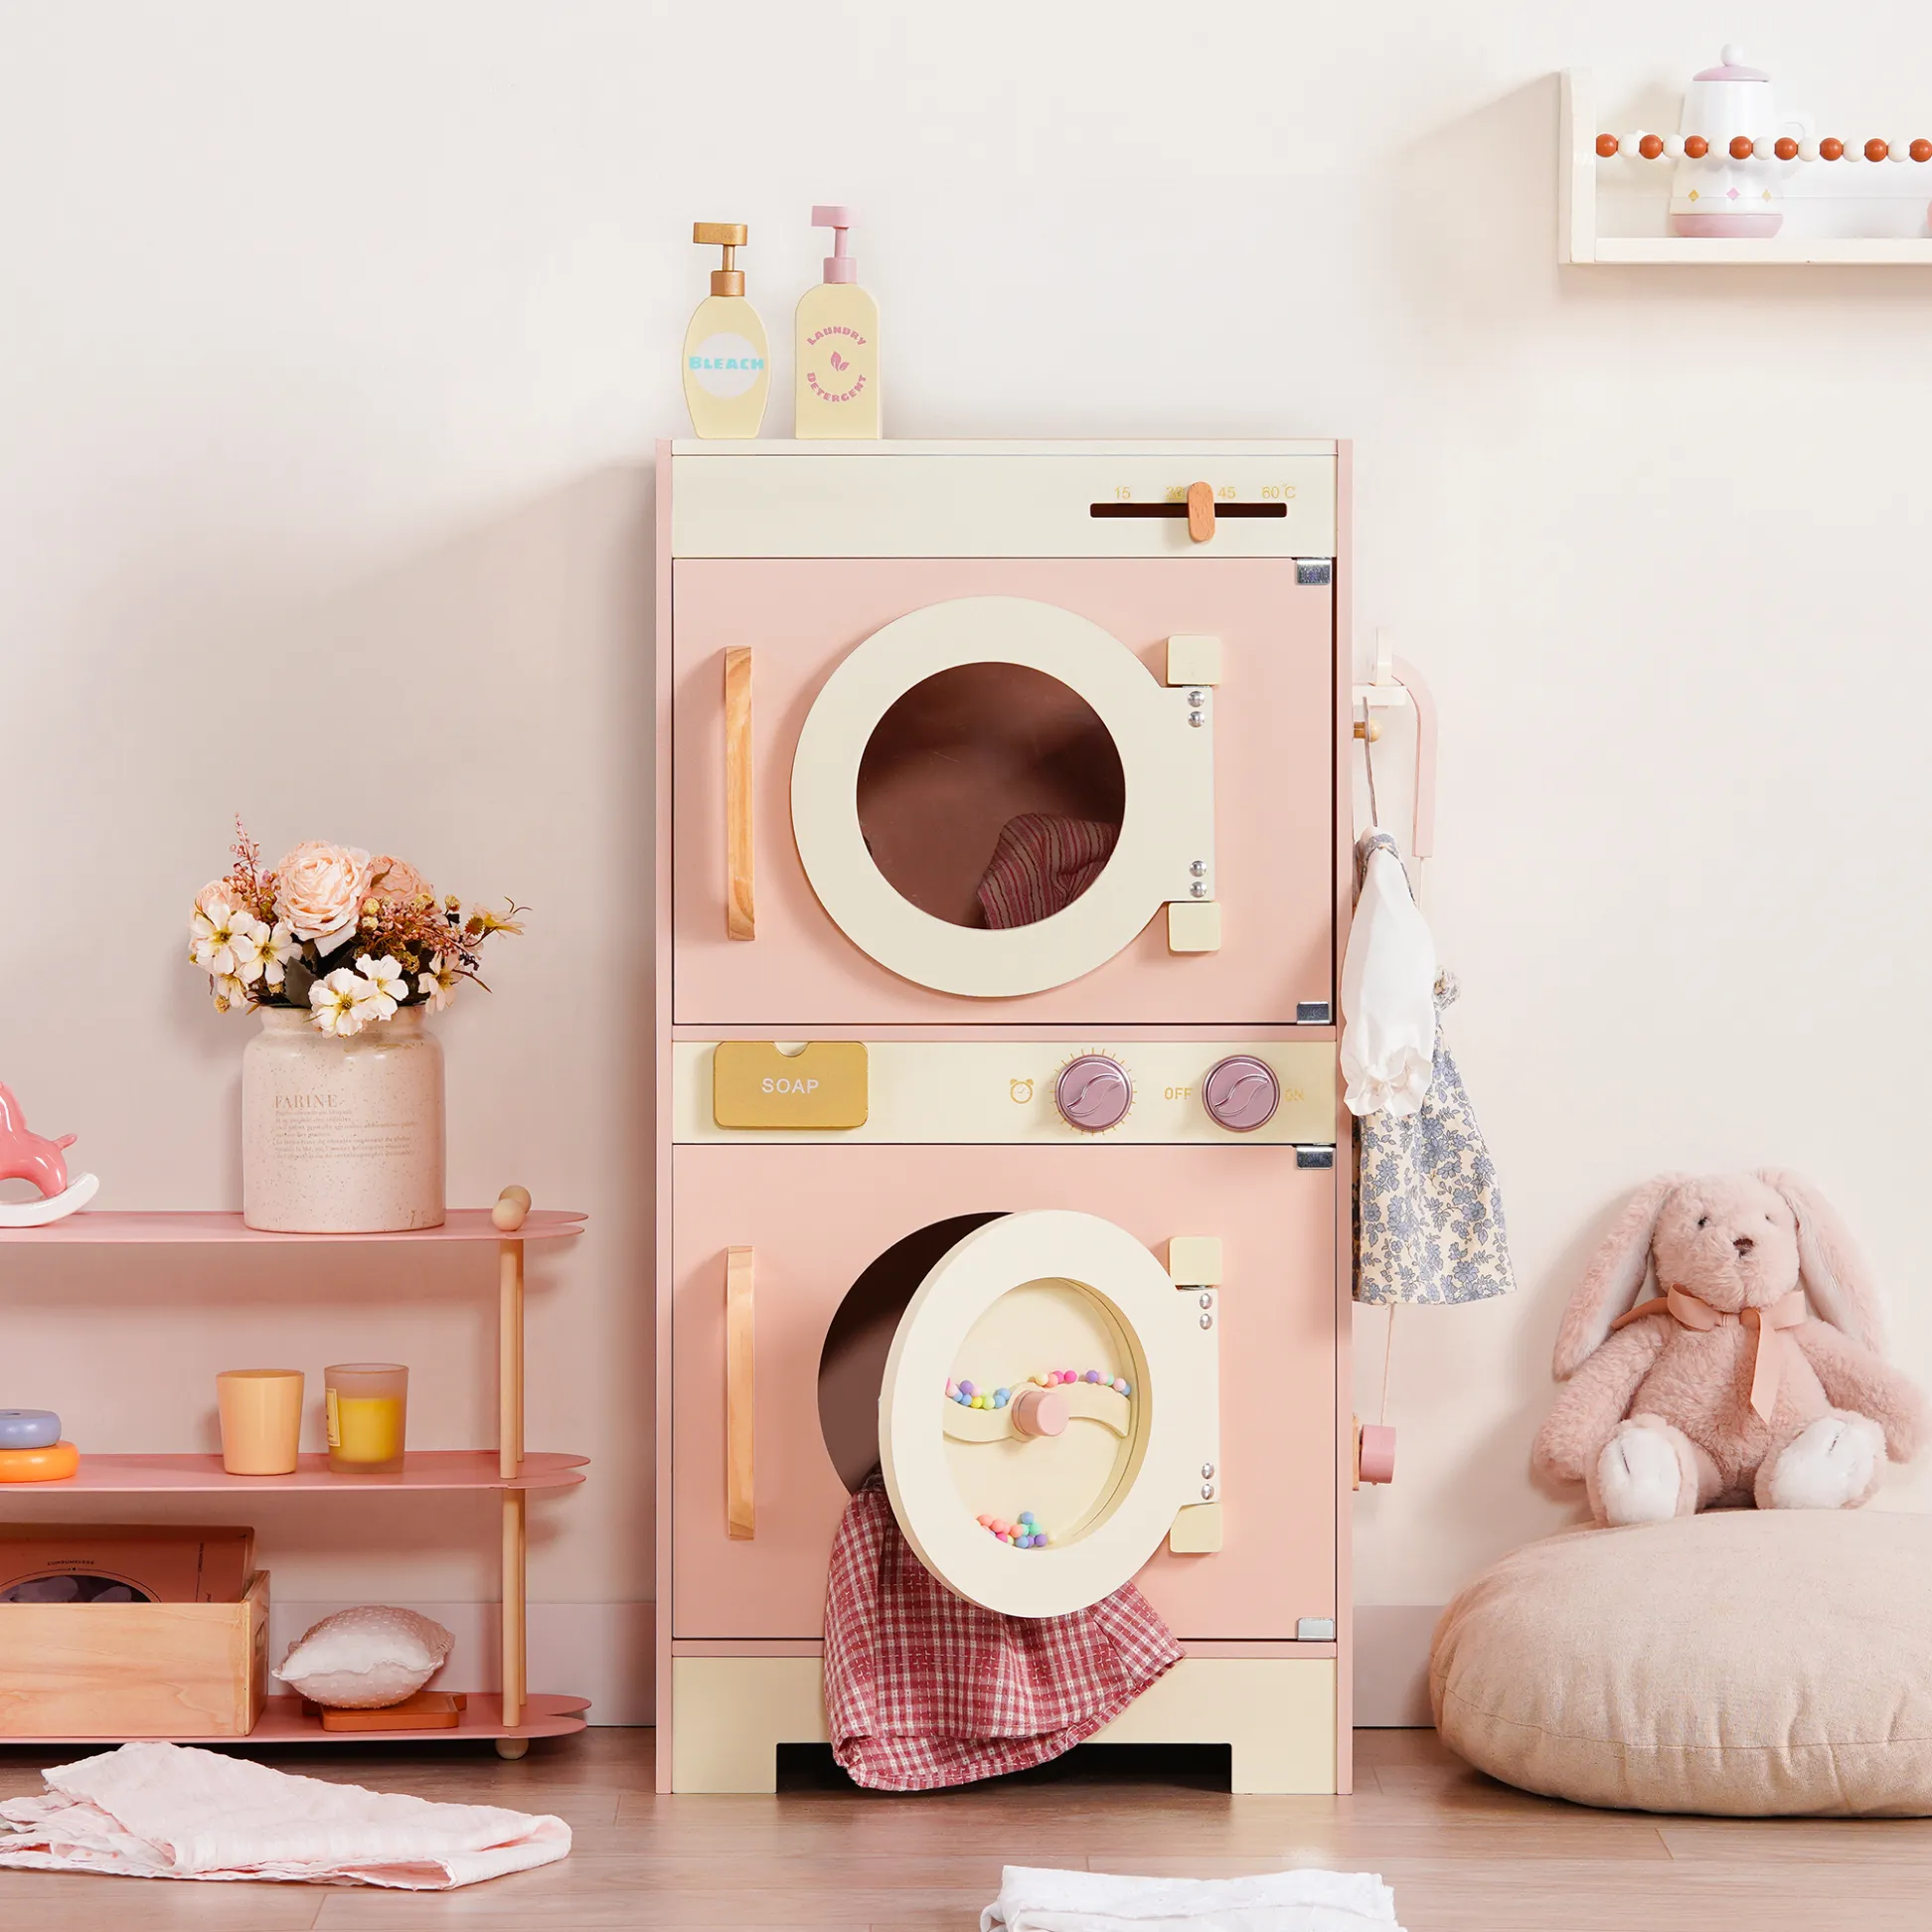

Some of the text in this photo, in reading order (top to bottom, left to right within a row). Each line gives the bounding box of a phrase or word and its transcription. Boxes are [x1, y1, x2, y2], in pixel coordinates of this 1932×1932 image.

[807, 326, 867, 346] LAUNDRY
[689, 356, 764, 371] BLEACH
[807, 372, 867, 402] DETERGENT
[1114, 486, 1131, 499] 15
[1218, 486, 1236, 499] 45
[761, 1077, 819, 1093] SOAP
[275, 1094, 338, 1109] FARINE
[1164, 1087, 1305, 1101] OFF ON
